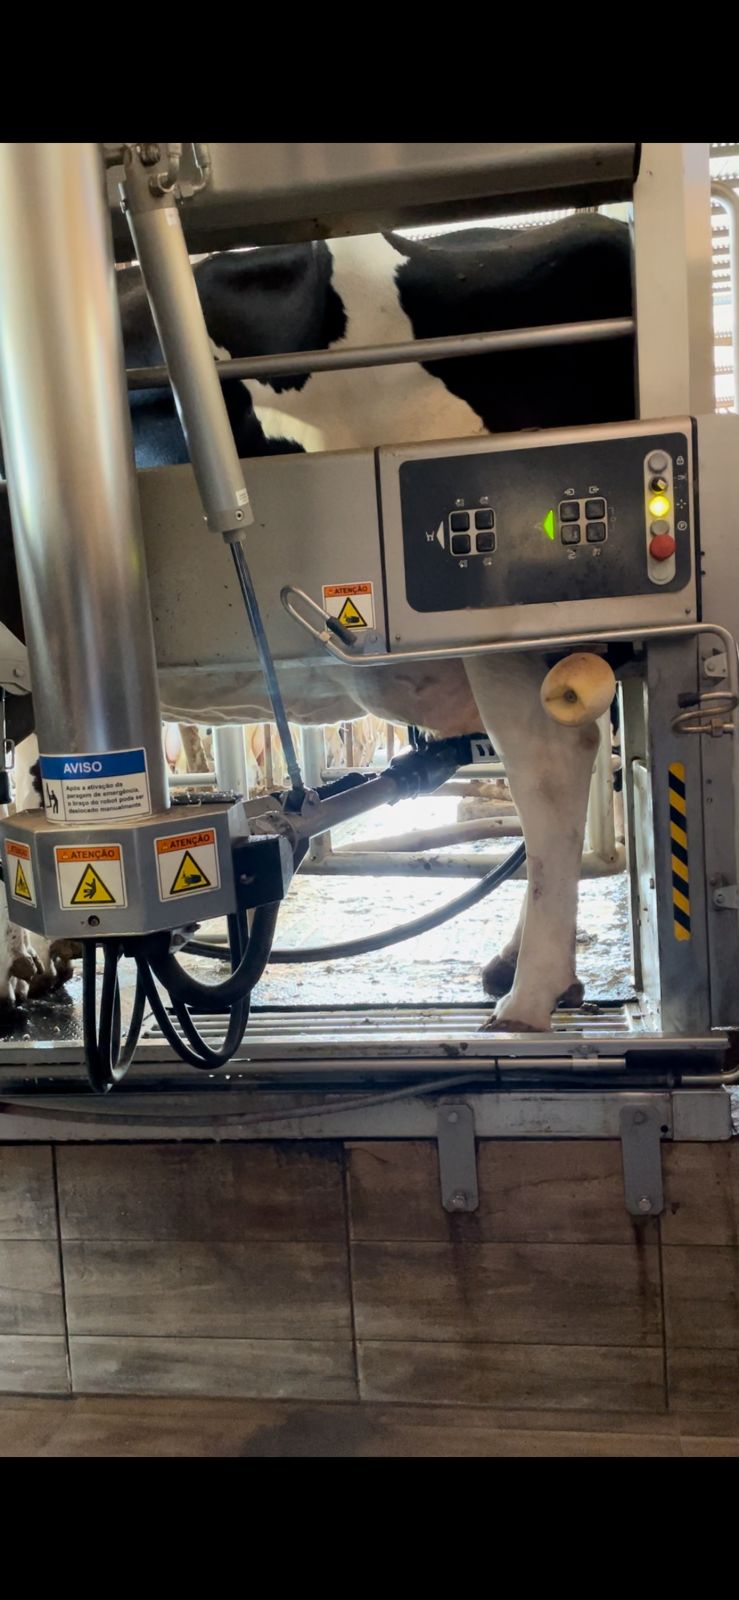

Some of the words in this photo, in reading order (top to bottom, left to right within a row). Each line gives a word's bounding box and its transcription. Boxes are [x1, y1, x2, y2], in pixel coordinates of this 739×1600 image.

[334, 585, 368, 594] ATENÇÃO
[63, 761, 102, 774] AVISO
[119, 796, 134, 804] pode
[101, 803, 141, 811] manualmente
[170, 835, 210, 848] ATENÇÃO
[71, 849, 115, 859] ATENÇÃO
